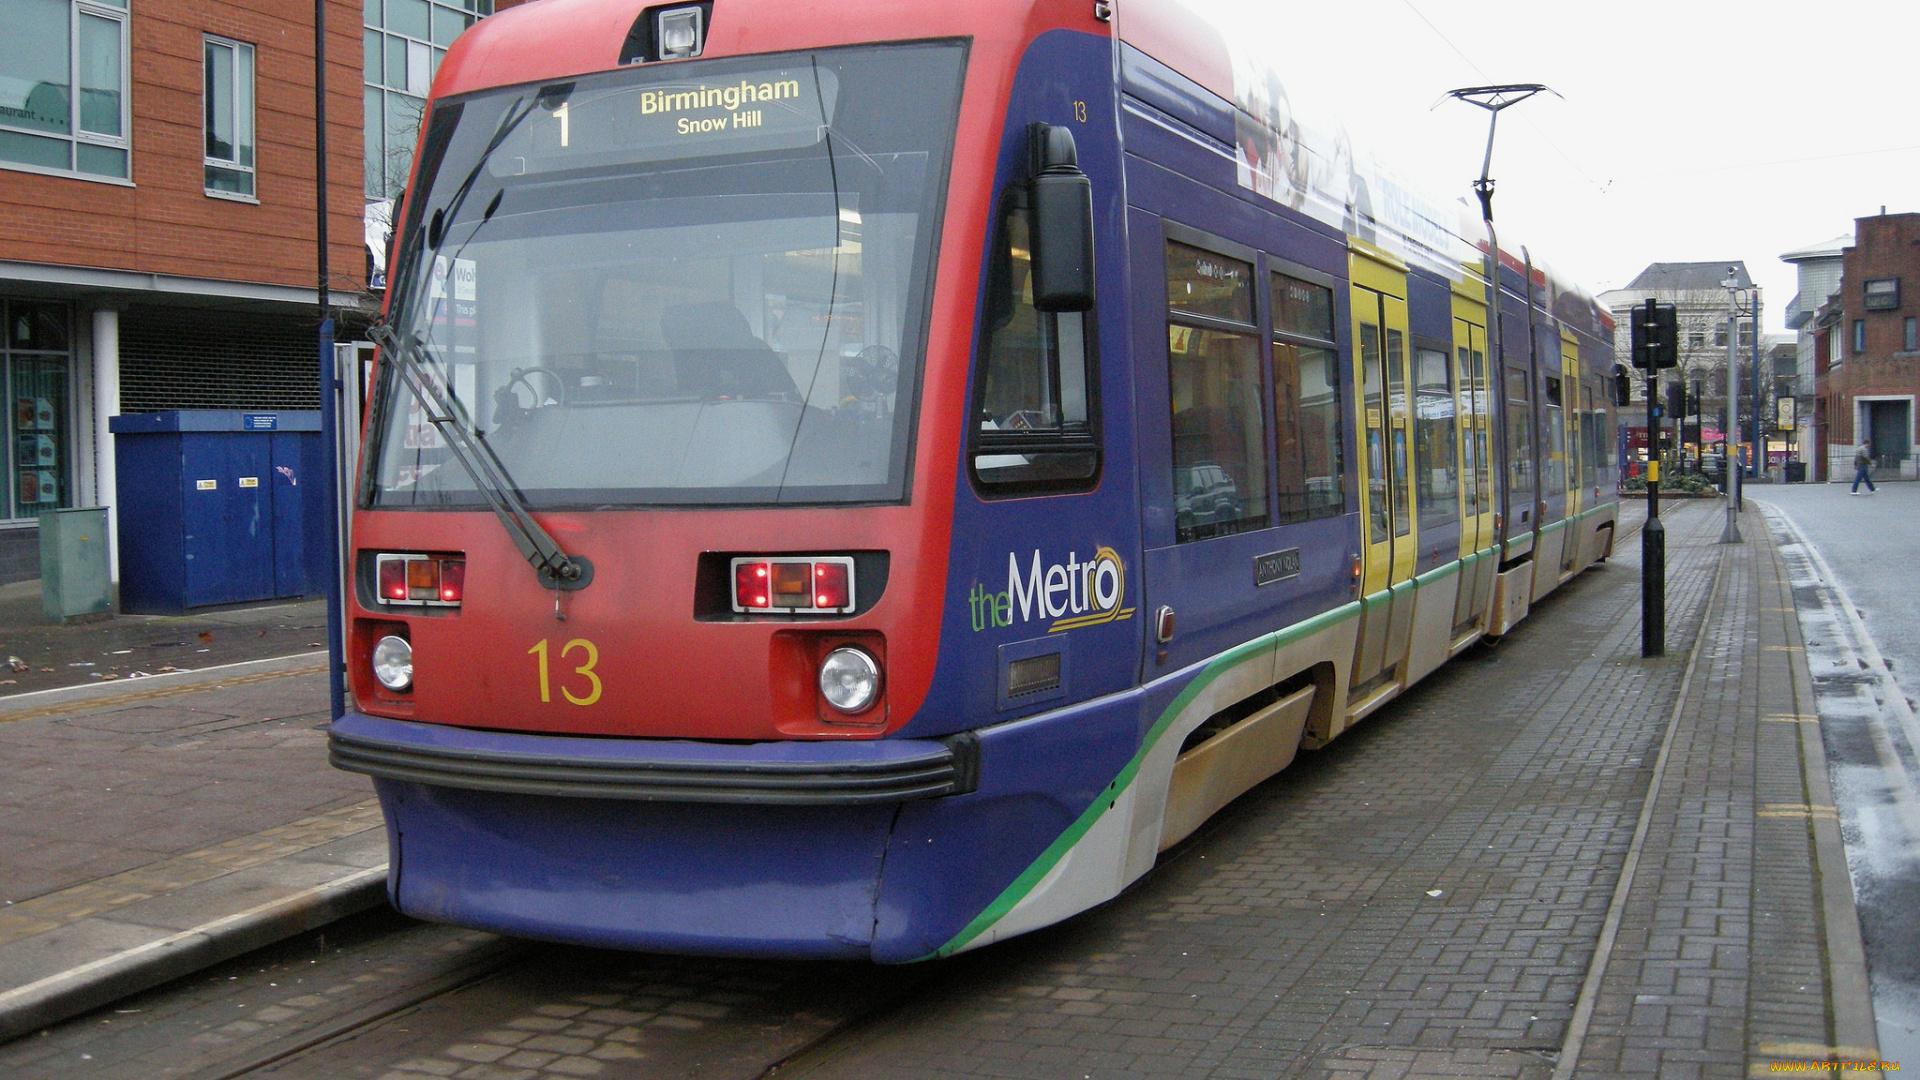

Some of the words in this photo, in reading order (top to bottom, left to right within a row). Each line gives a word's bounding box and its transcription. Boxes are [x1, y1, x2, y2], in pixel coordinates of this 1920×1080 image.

[641, 80, 799, 115] Birmingham
[1073, 100, 1087, 123] 13
[552, 102, 569, 147] 1
[677, 117, 728, 135] Snow
[732, 110, 762, 129] Hill
[1008, 549, 1120, 625] Metro
[527, 638, 602, 706] 13
